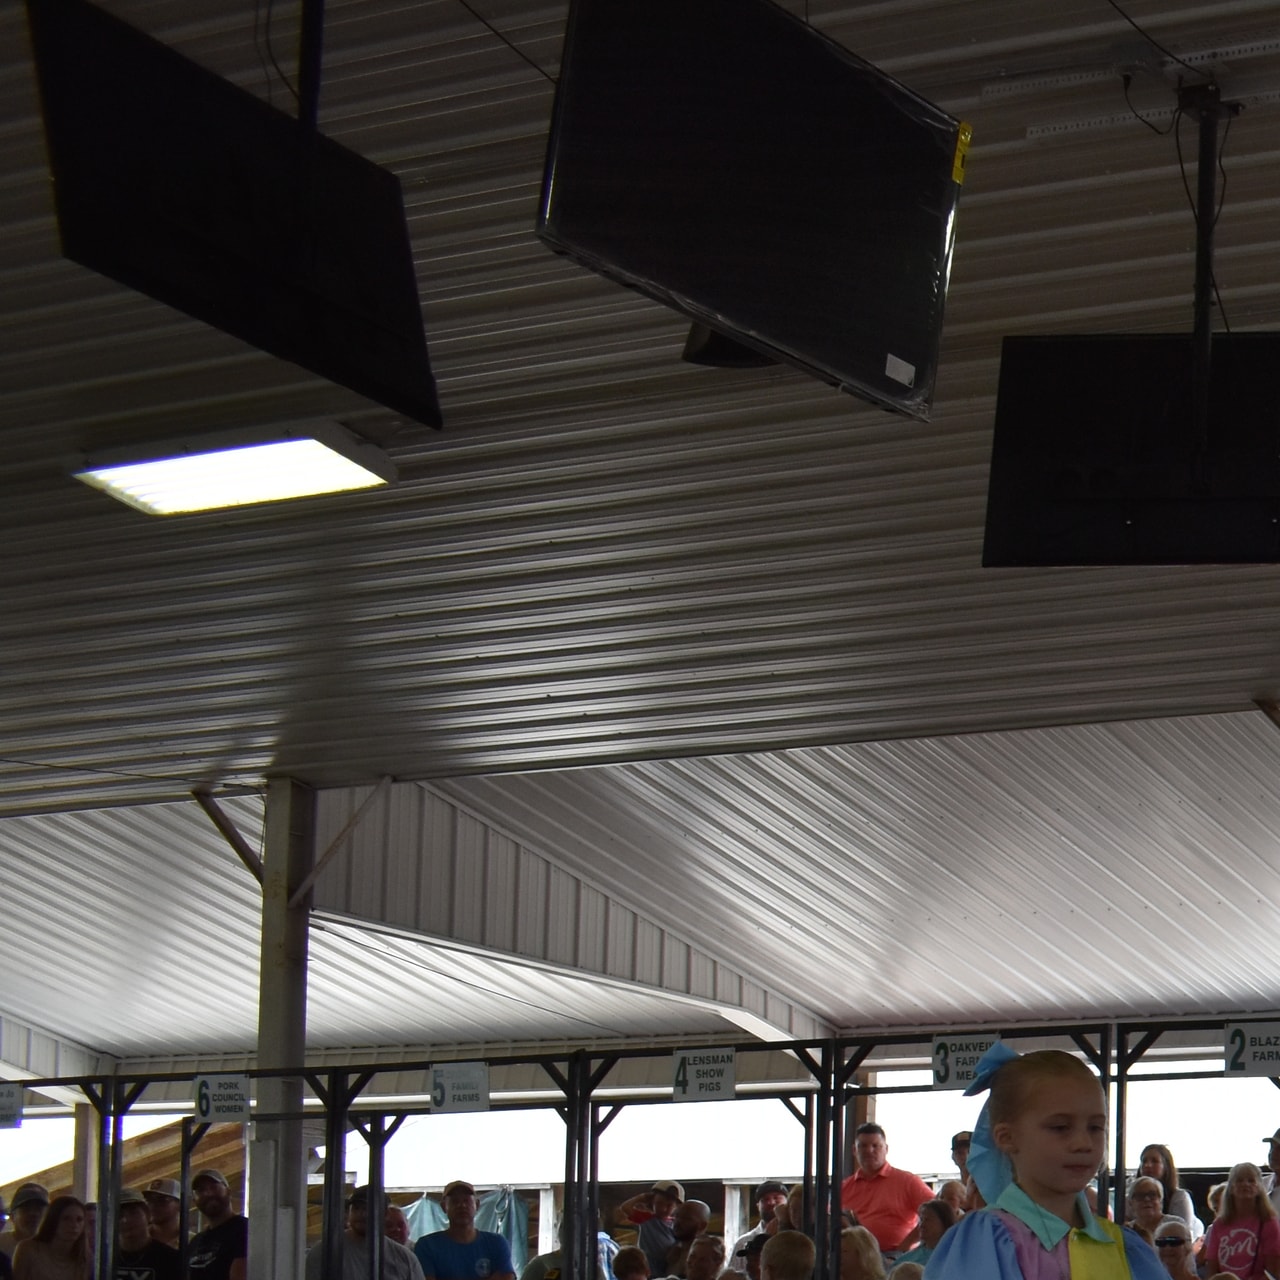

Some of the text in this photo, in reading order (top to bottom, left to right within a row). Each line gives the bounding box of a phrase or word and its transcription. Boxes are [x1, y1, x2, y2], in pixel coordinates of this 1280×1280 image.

[1230, 1028, 1246, 1071] 2
[688, 1054, 733, 1066] LENSMAN
[935, 1042, 949, 1084] 3
[675, 1056, 688, 1094] 4
[695, 1068, 725, 1078] SHOW
[218, 1082, 240, 1091] PORK
[433, 1069, 445, 1107] 5
[698, 1082, 721, 1091] PIGS
[199, 1080, 210, 1117] 6
[212, 1094, 246, 1102] COUNCIL
[452, 1093, 480, 1102] FARMS
[215, 1105, 244, 1113] WOMEN
